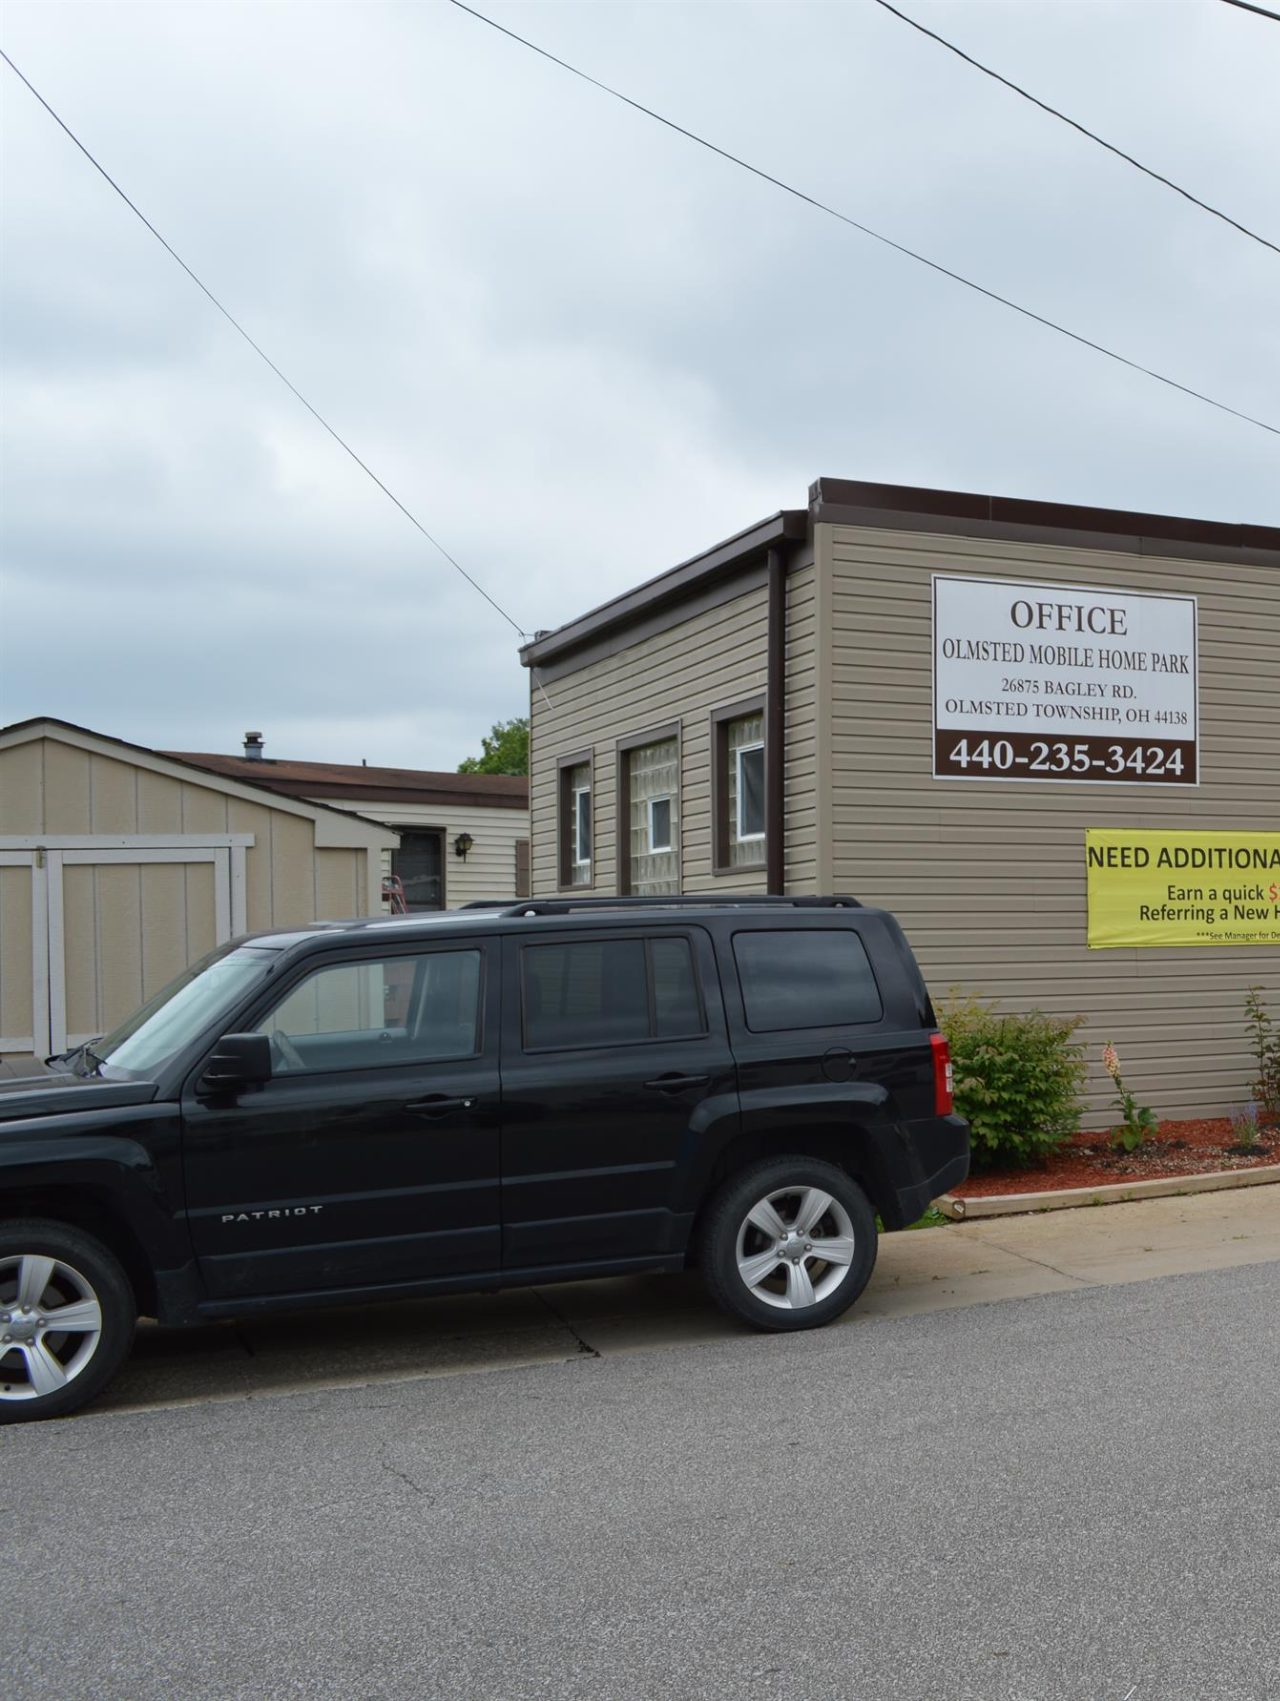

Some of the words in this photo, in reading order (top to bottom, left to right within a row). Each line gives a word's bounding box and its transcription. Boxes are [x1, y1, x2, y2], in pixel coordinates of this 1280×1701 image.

[1010, 600, 1128, 636] OFFICE
[942, 638, 1025, 663] OLMSTED
[1029, 644, 1094, 668] MOBILE
[1099, 649, 1148, 672] HOME
[1151, 653, 1189, 674] PARK
[1001, 677, 1040, 694] 26875
[1044, 681, 1108, 698] BAGLEY
[1112, 684, 1137, 699] RD.
[945, 699, 1028, 717] OLMSTED
[1032, 703, 1122, 724] TOWNSHIP,
[1125, 708, 1150, 723] OH
[1154, 709, 1188, 725] 44138
[949, 738, 1185, 776] 440-235-3424
[1088, 846, 1150, 868] NEED
[1167, 885, 1204, 901] Earn
[1208, 888, 1217, 901] a
[1222, 884, 1265, 905] quick
[1139, 904, 1215, 925] Referring
[1219, 907, 1228, 920] a
[1233, 904, 1269, 920] New
[1224, 932, 1257, 941] Manager
[1258, 931, 1269, 940] for
[221, 1205, 324, 1223] PATRIOT
